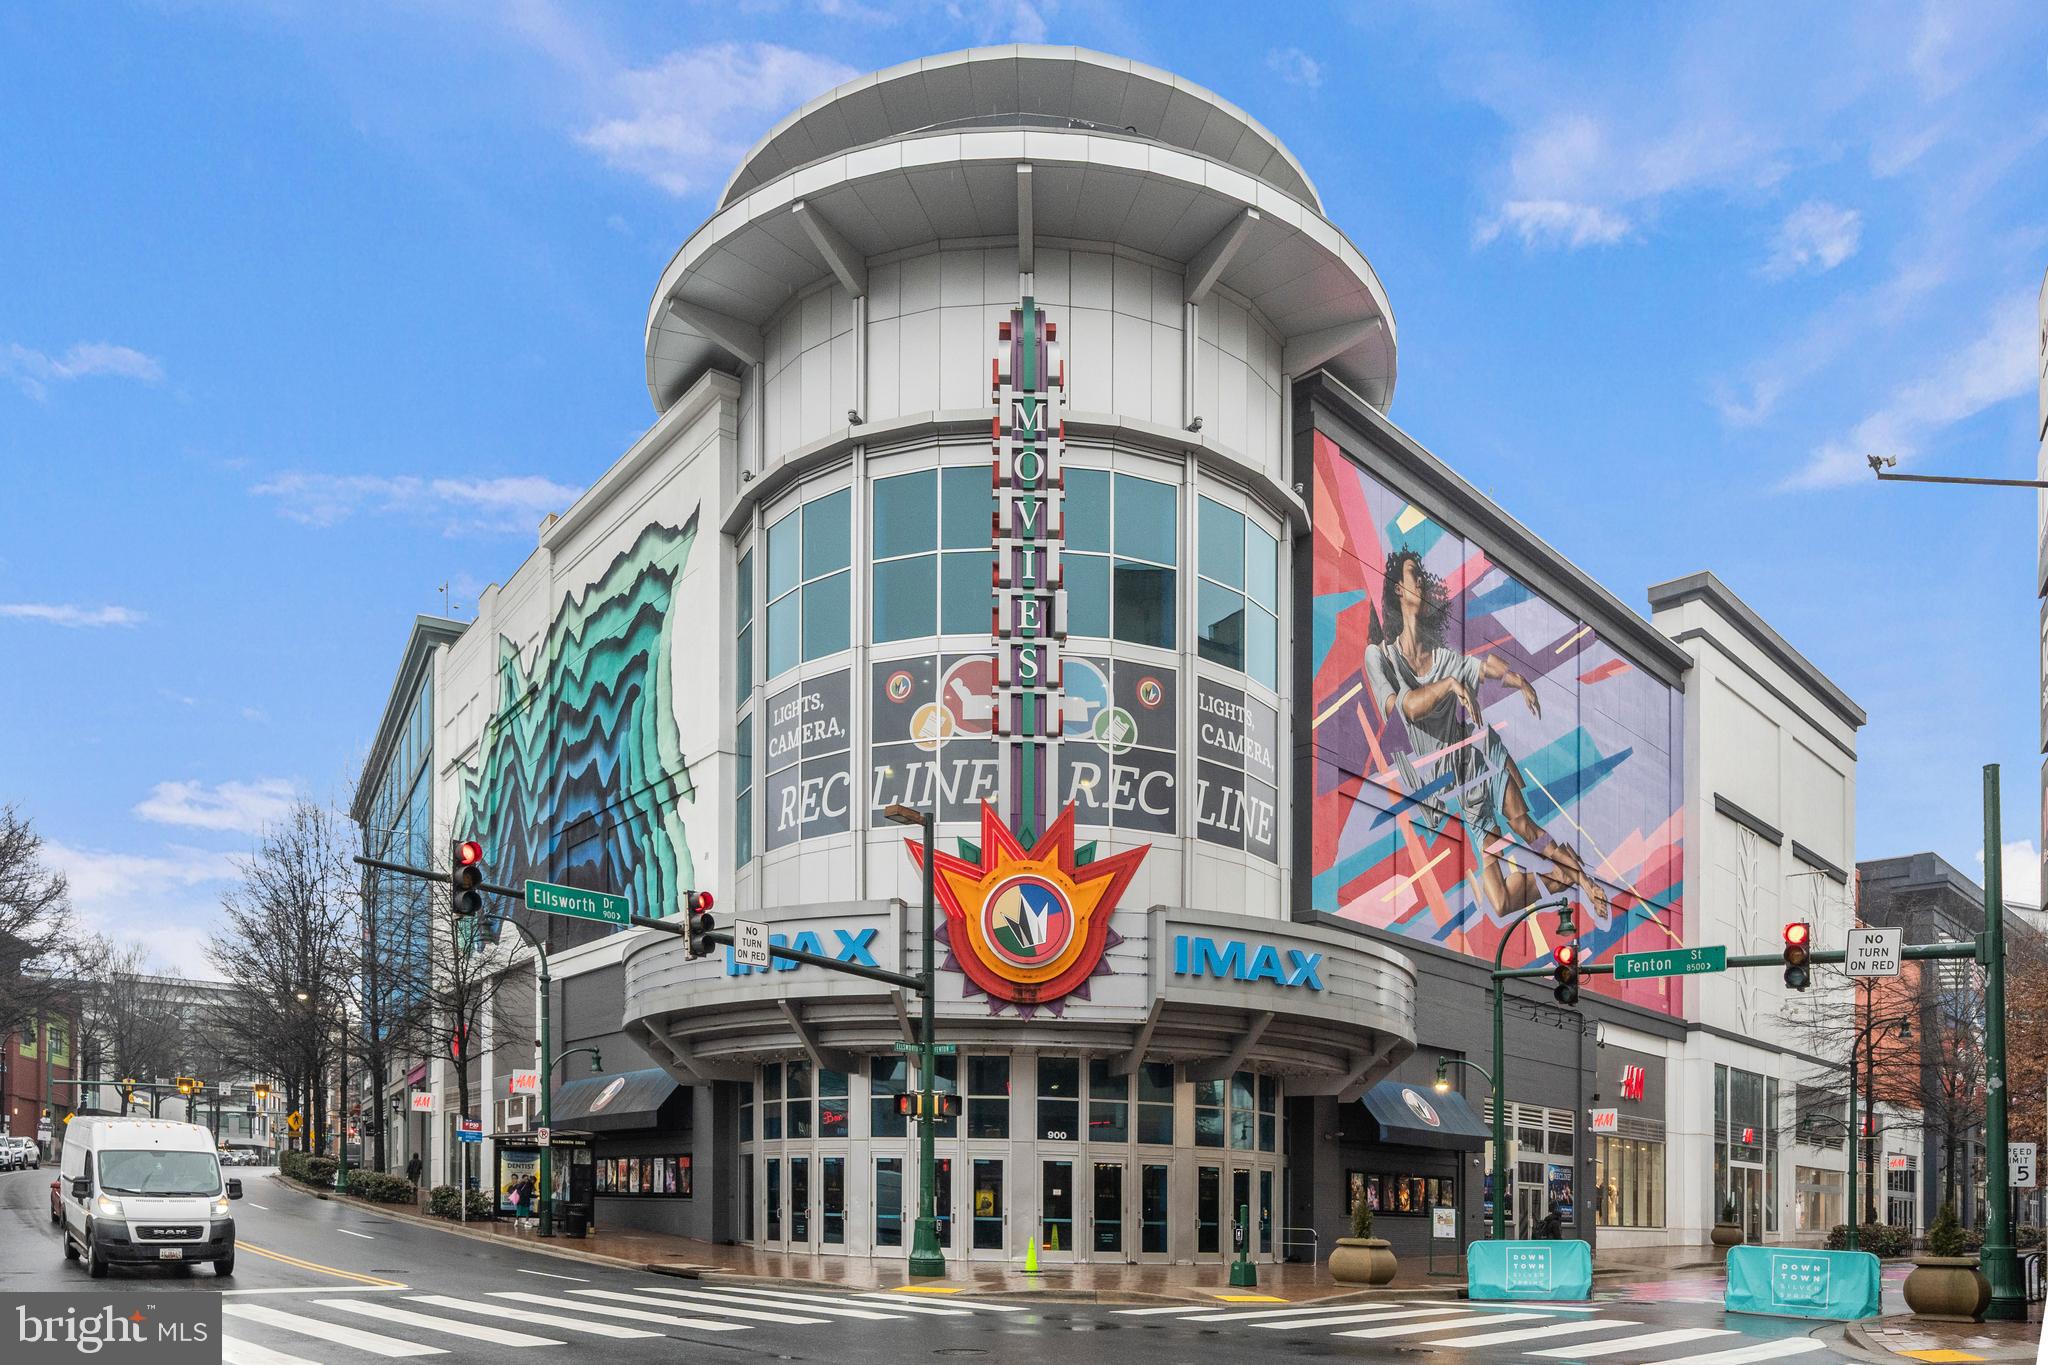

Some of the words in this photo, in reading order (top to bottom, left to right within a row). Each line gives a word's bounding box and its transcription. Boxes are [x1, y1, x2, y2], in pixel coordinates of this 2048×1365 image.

[1012, 402, 1047, 679] MOVIES
[774, 692, 825, 726] LIGHTS,
[1199, 692, 1255, 730] LIGHTS,
[769, 717, 846, 757] CAMERA,
[1201, 723, 1275, 772] CAMERA,
[534, 888, 596, 913] Ellsworth
[603, 897, 614, 909] Dr
[602, 910, 616, 919] 900
[745, 926, 758, 936] NO
[742, 938, 762, 948] TURN
[1865, 935, 1883, 944] NO
[737, 949, 748, 959] ON
[752, 951, 766, 961] RED
[1858, 947, 1889, 957] TURN
[1175, 935, 1325, 991] IMAX
[1627, 959, 1672, 973] Fenton
[1691, 949, 1702, 960] St
[1686, 962, 1705, 971] 8500
[1850, 960, 1866, 970] ON
[1872, 960, 1895, 970] RED
[1594, 1113, 1614, 1127] H&M
[1047, 1130, 1067, 1140] 900
[508, 1162, 535, 1170] DENTIST
[2017, 1166, 2029, 1181] 5
[1781, 1263, 1821, 1272] DOWN
[1781, 1273, 1821, 1282] TOWN
